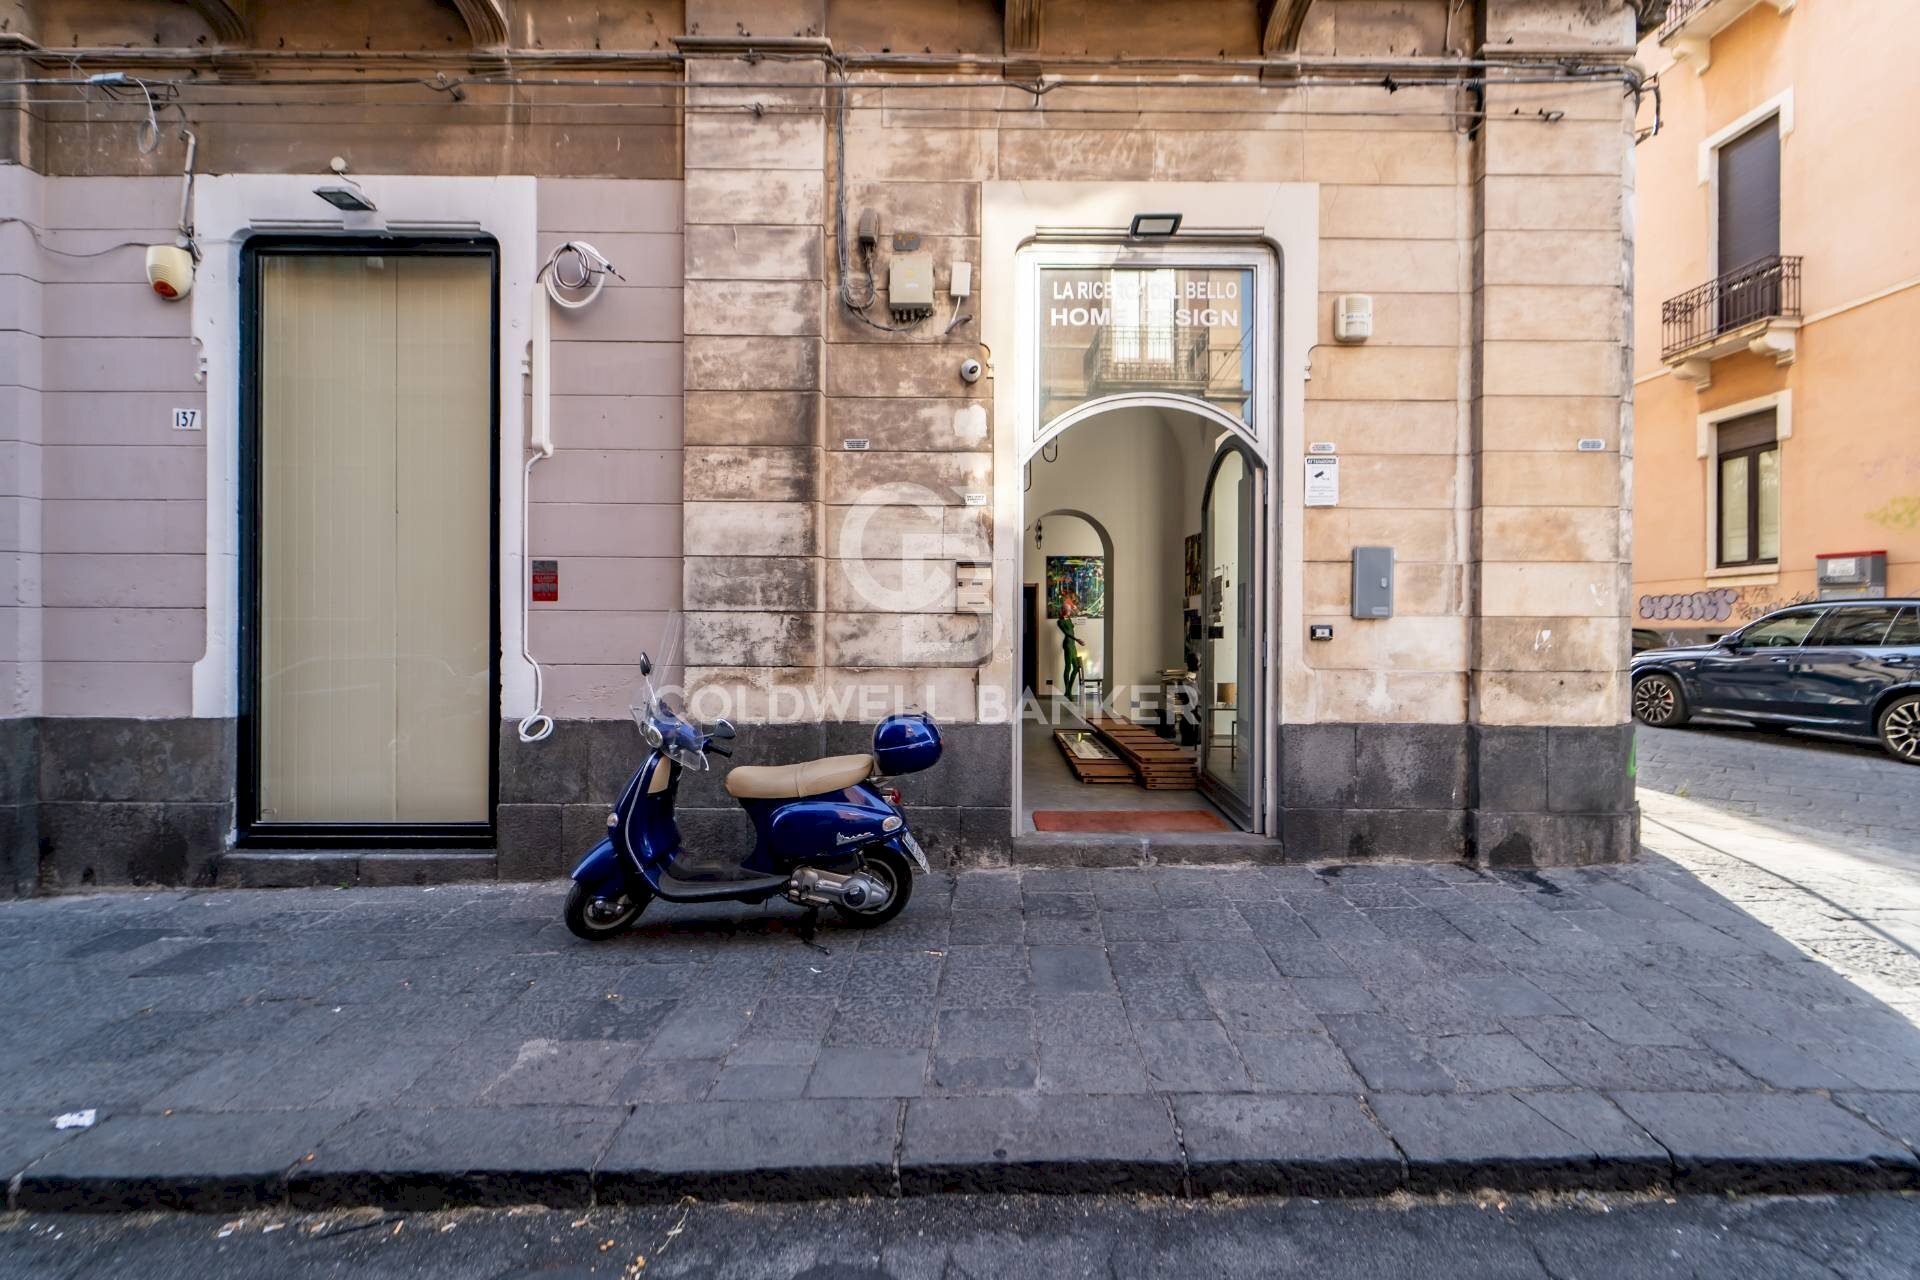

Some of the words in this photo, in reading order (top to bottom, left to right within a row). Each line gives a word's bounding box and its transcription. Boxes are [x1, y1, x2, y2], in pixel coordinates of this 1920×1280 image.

[1052, 281, 1075, 300] LA
[1186, 281, 1238, 299] BELLO
[176, 411, 196, 427] 137
